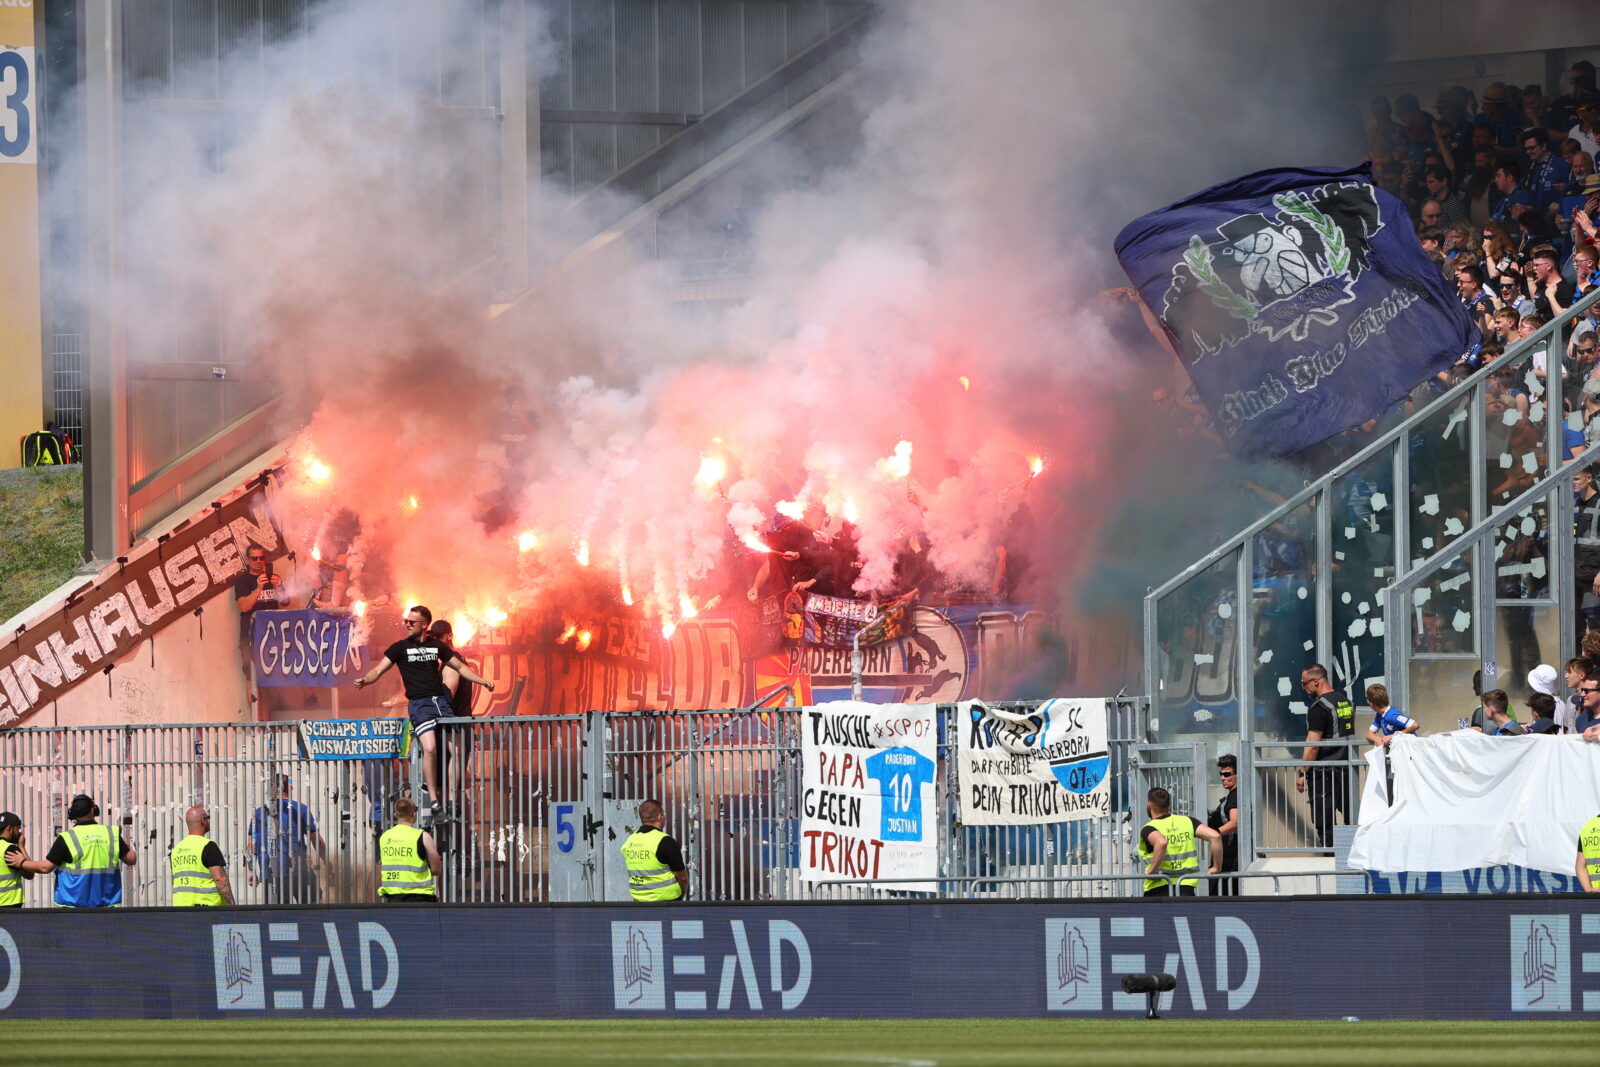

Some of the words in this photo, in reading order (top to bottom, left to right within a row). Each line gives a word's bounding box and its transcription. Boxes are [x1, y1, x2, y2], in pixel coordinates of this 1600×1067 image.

[0, 51, 30, 158] 3
[807, 596, 863, 618] AMBIENTE
[259, 618, 362, 676] GESSELN
[306, 720, 357, 737] SCHNAPS
[360, 720, 369, 736] &
[371, 720, 403, 735] WEED
[808, 711, 876, 748] TAUSCHE
[1065, 707, 1083, 733] SC
[971, 759, 993, 775] DARF
[1030, 736, 1090, 762] PADERBORN
[819, 751, 865, 790] PAPA
[1069, 766, 1087, 789] 07
[804, 788, 862, 828] GEGEN
[889, 772, 913, 813] 10
[972, 784, 1003, 815] DEIN
[1008, 780, 1059, 817] TRIKOT
[555, 805, 575, 853] 5
[380, 846, 413, 857] RDNER
[803, 830, 885, 880] TRIKOT
[268, 921, 400, 1009] EAD
[671, 919, 813, 1010] EAD
[1110, 915, 1261, 1011] EAD
